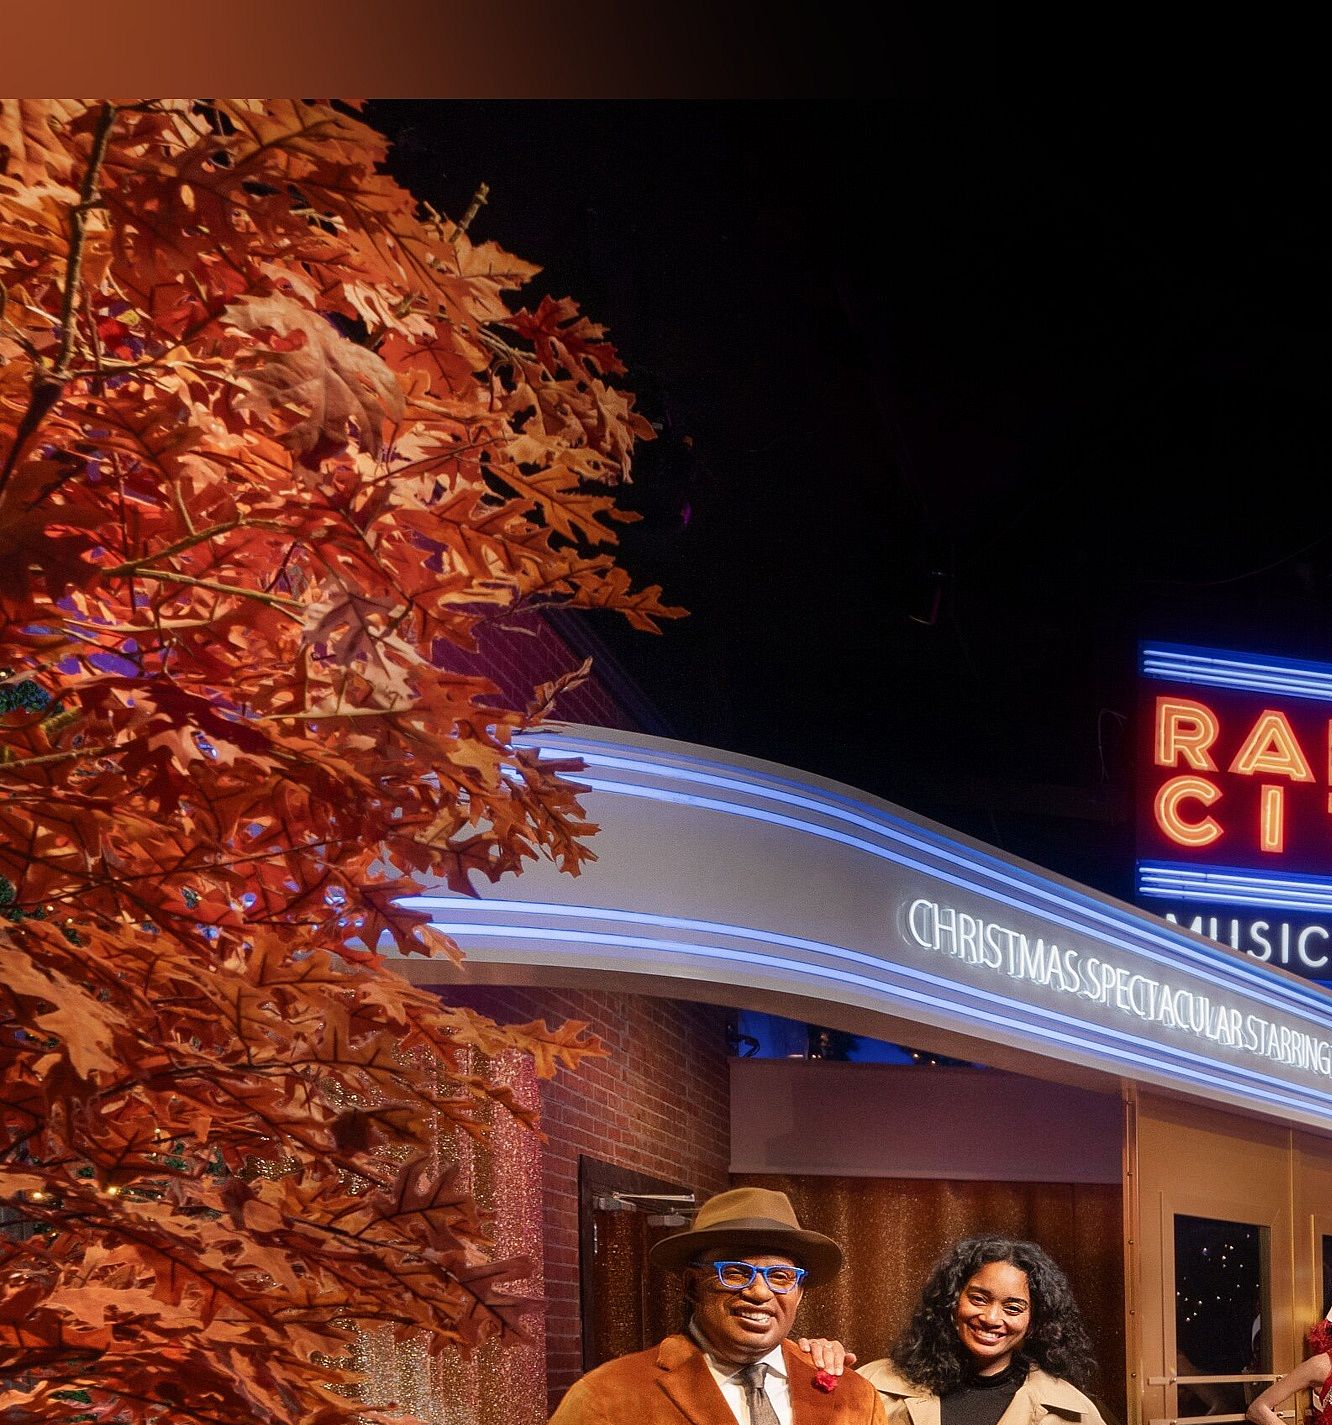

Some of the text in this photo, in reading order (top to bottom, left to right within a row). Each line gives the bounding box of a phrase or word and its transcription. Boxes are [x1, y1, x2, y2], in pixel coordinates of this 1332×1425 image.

[906, 899, 1080, 993] CHRISTMAS
[1086, 957, 1243, 1049] SPECTACULAR
[1246, 1014, 1331, 1075] STARRING
